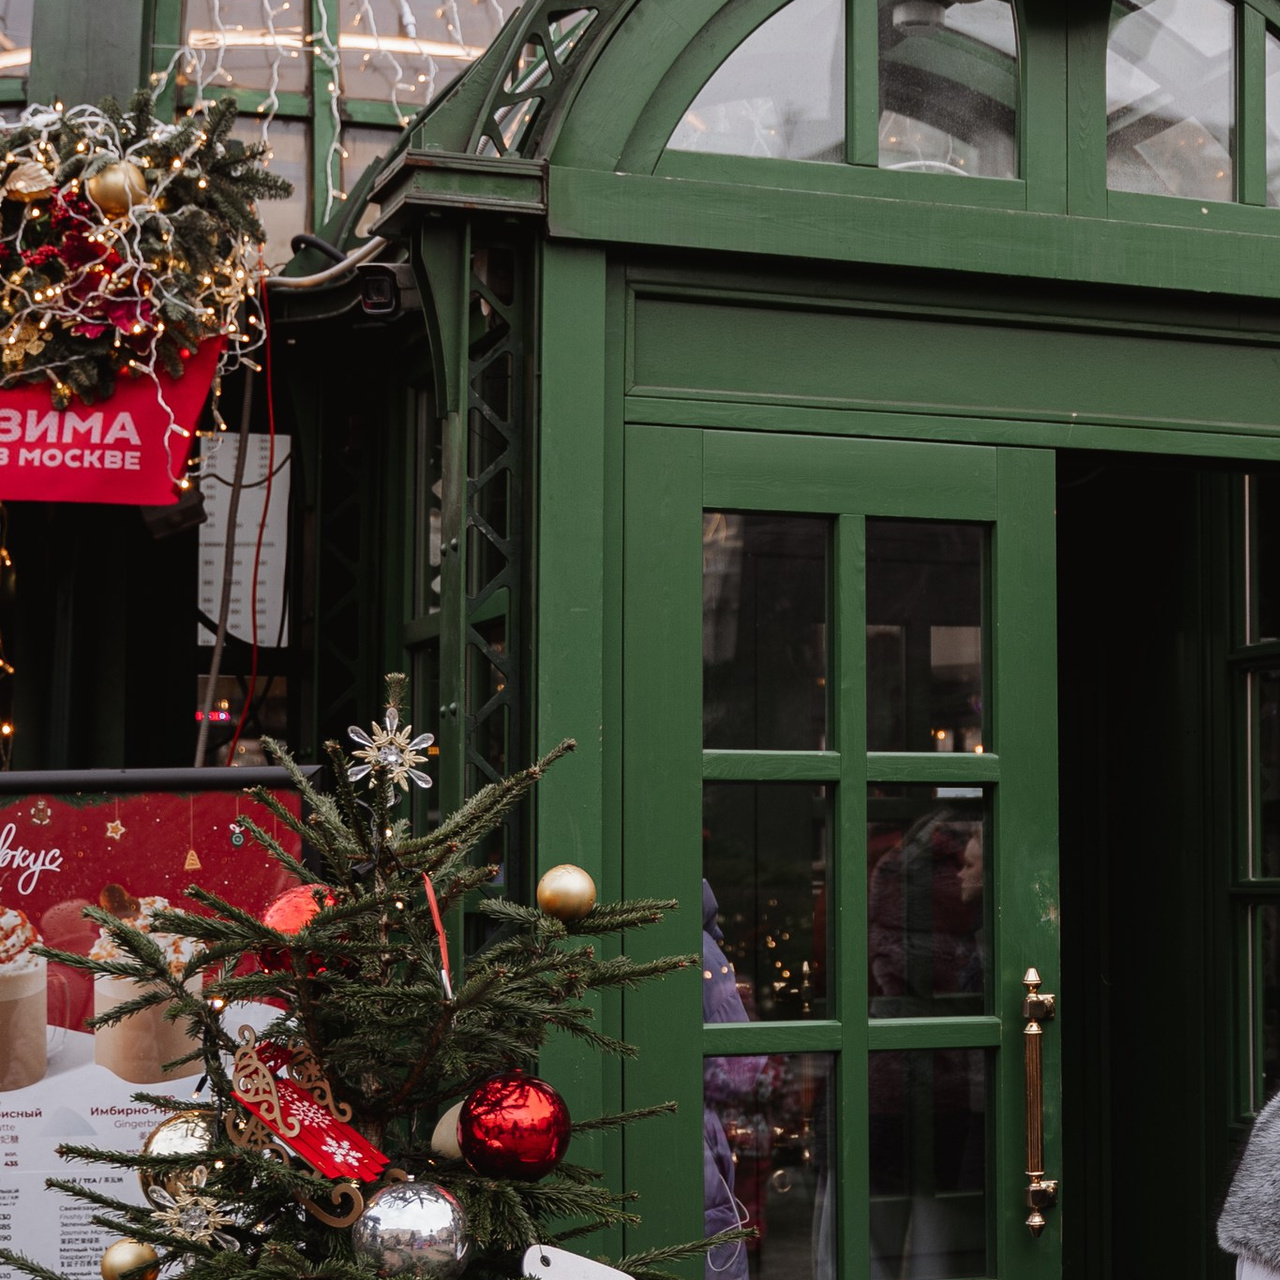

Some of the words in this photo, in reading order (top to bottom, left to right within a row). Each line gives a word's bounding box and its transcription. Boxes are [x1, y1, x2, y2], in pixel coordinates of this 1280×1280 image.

[0, 408, 142, 446] ЗИМА
[18, 448, 142, 470] МОСКВЕ
[0, 1108, 42, 1119] исный
